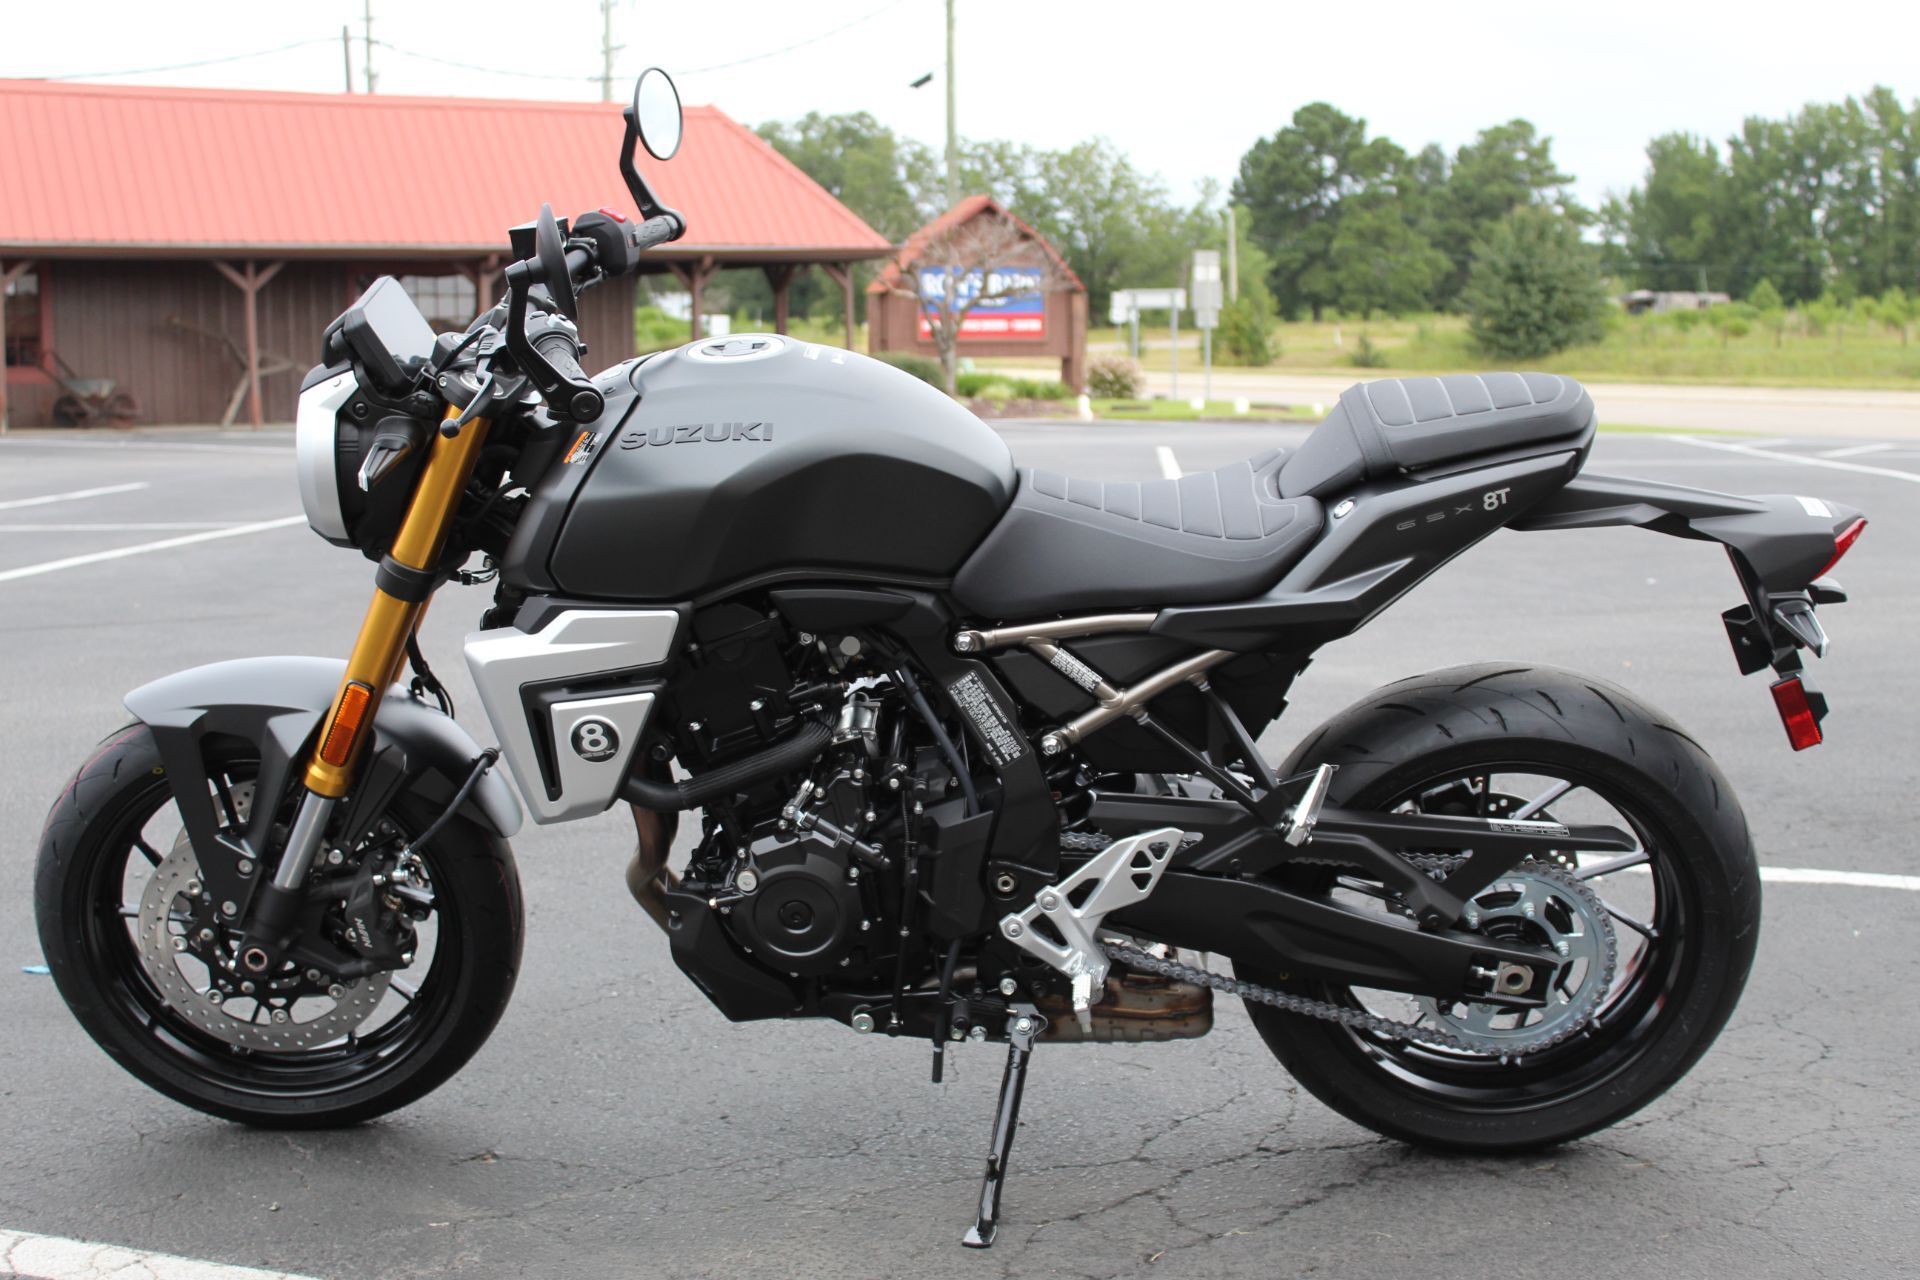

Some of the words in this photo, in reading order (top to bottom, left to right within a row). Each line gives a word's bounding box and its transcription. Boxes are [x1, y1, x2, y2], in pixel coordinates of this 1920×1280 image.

[620, 422, 774, 450] SUZUKI
[1482, 487, 1511, 512] 8T
[580, 723, 609, 752] 8
